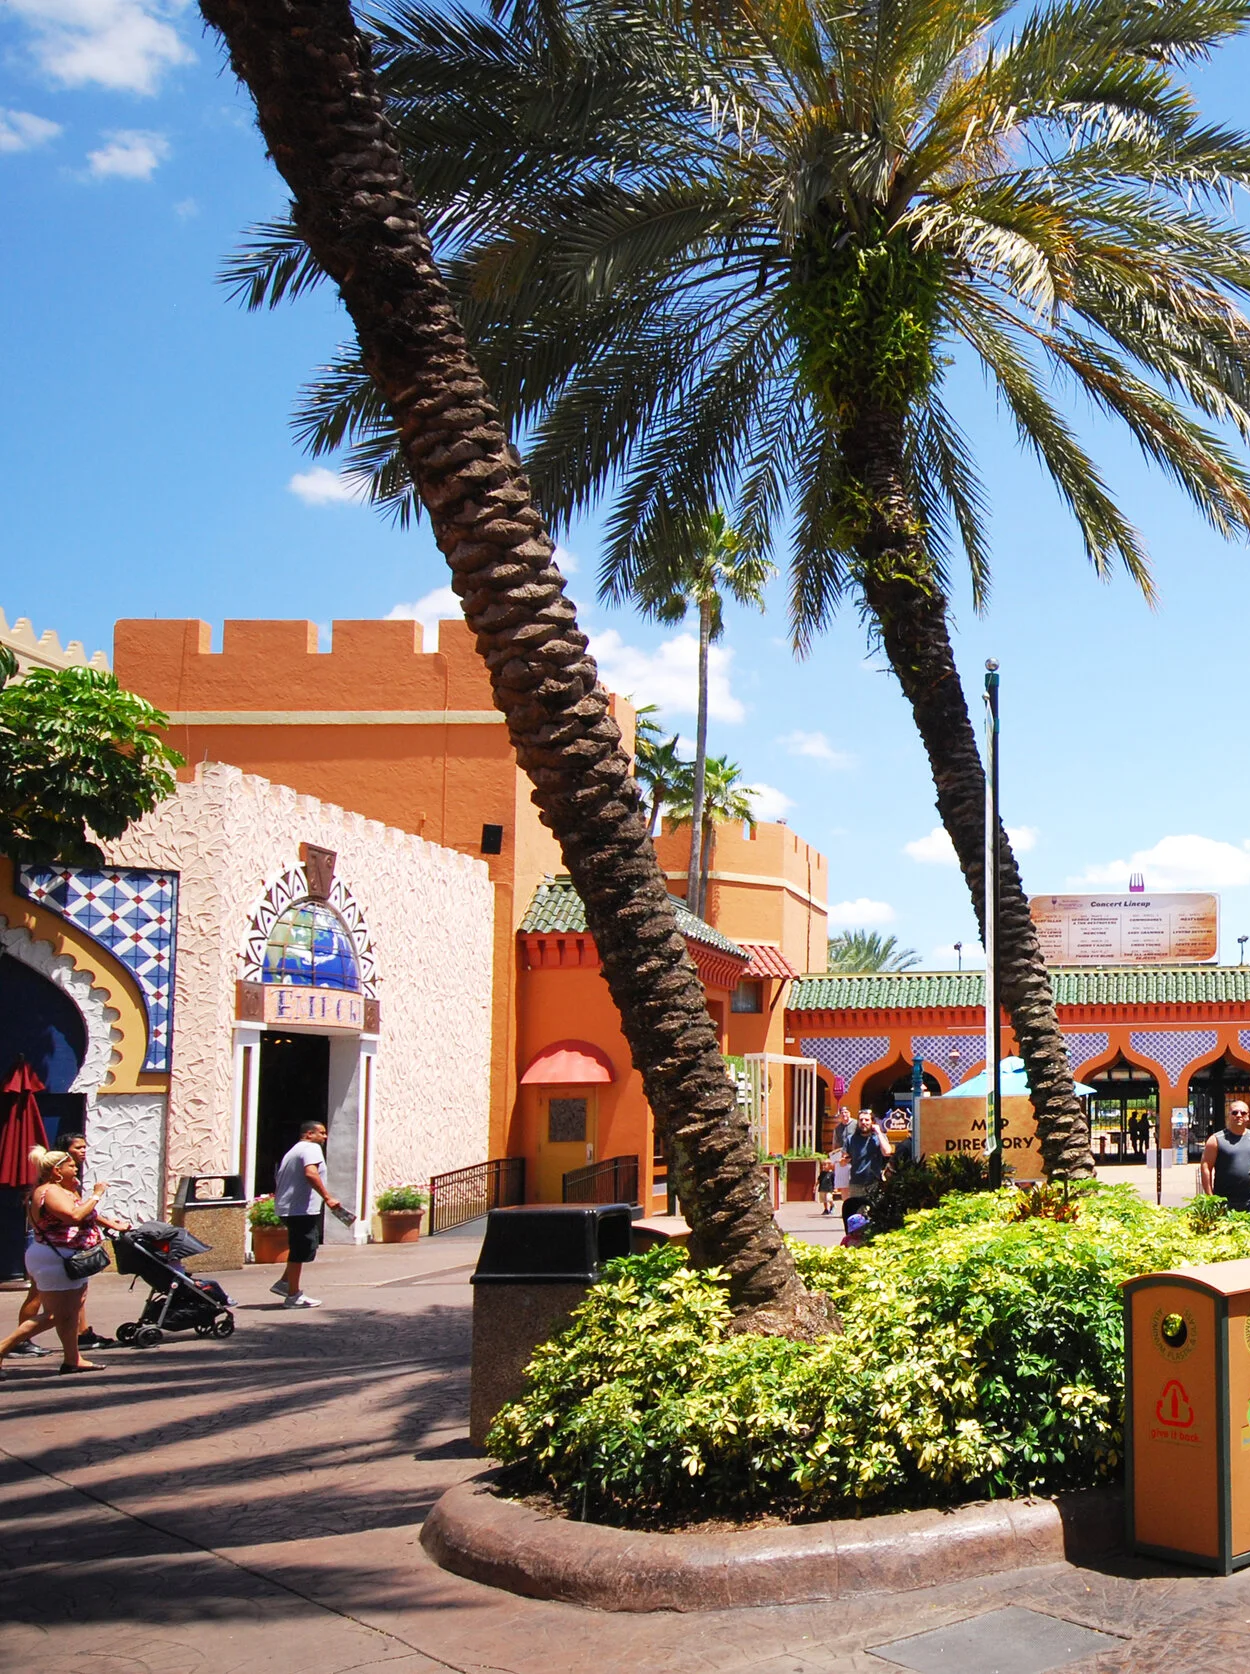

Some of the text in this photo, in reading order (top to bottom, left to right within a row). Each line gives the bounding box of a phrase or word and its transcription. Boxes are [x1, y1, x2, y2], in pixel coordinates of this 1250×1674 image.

[1123, 900, 1151, 908] Lineup
[971, 1118, 1009, 1131] MP
[945, 1137, 1034, 1151] DIRECORY
[1151, 1428, 1200, 1443] give it back
